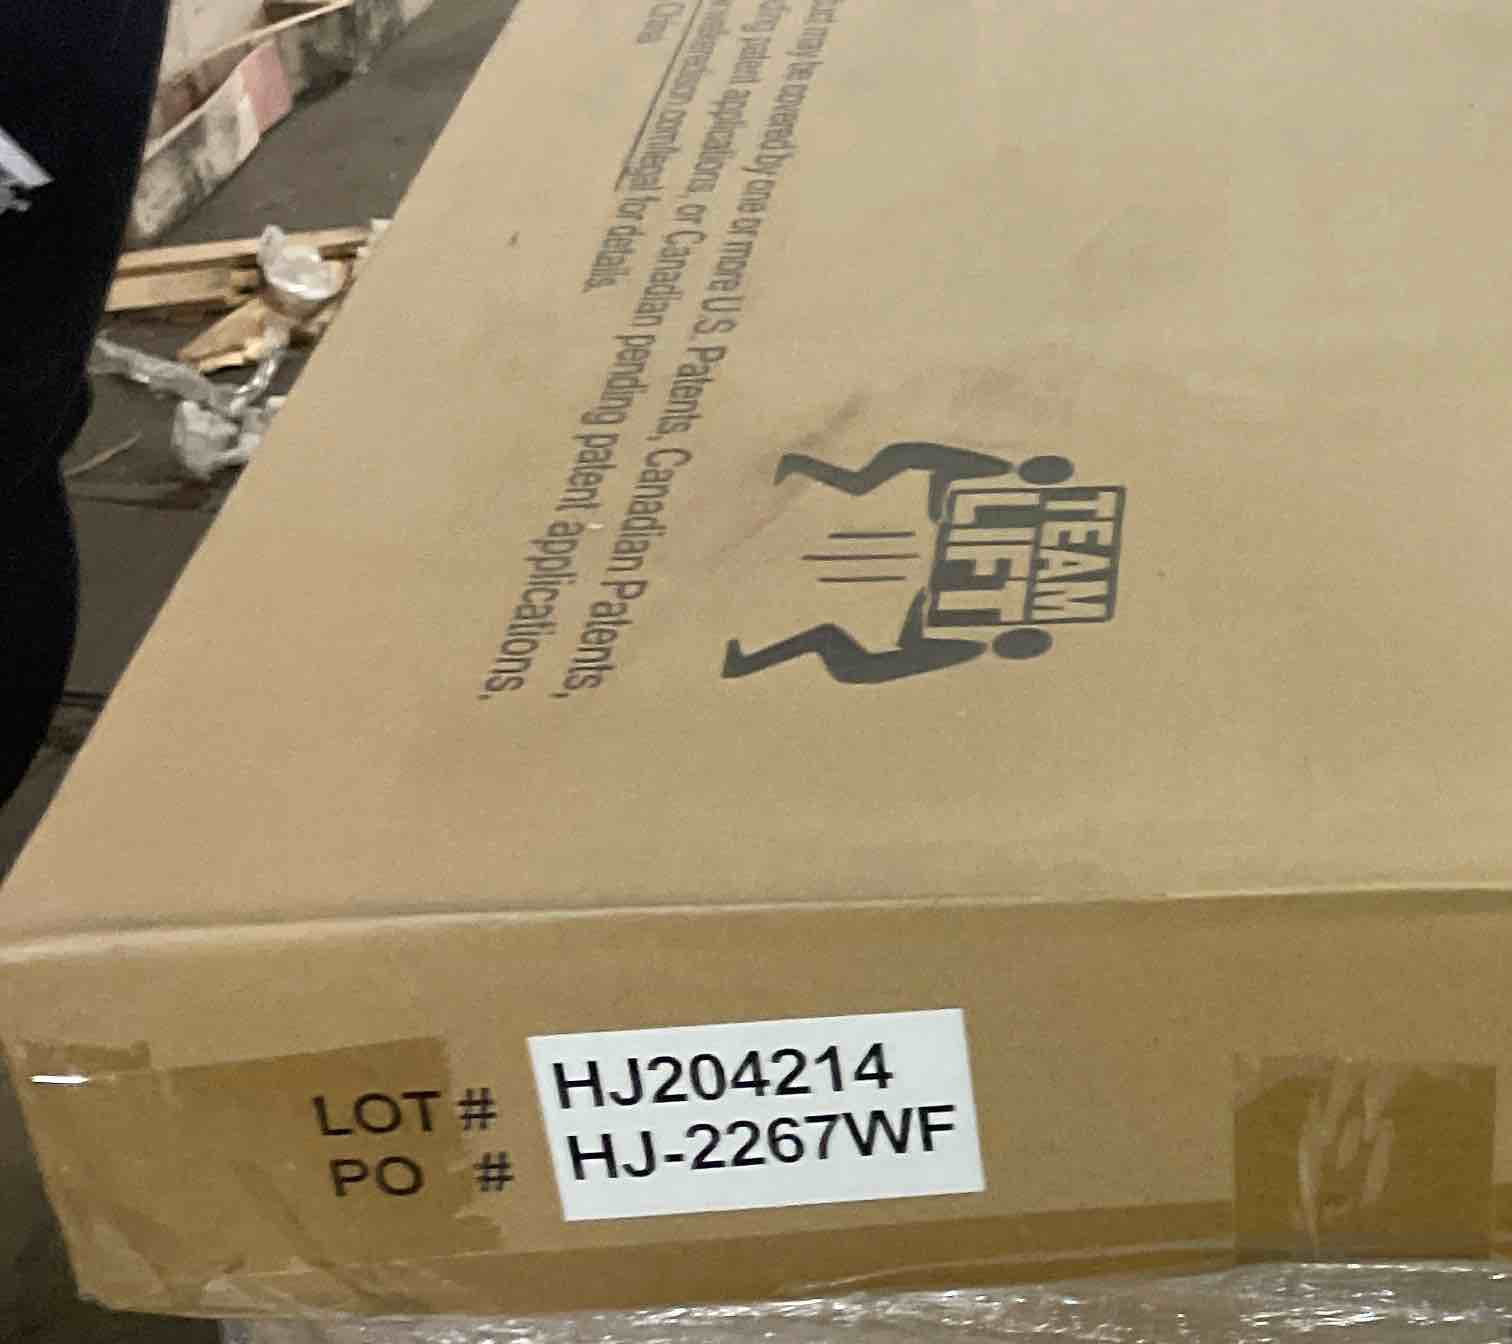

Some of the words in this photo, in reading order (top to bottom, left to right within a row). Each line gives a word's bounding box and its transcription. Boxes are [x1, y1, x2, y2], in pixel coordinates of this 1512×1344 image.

[758, 84, 808, 150] covered
[735, 179, 777, 213] one
[741, 146, 797, 176] by
[615, 196, 662, 220] for
[671, 204, 707, 225] or
[727, 217, 762, 236] or
[579, 224, 646, 294] details.
[628, 229, 708, 328] Canadian
[706, 240, 754, 291] more
[579, 334, 657, 425] pending
[645, 345, 728, 441] Patents,
[553, 433, 621, 512] patent
[605, 447, 694, 572] Canadian
[936, 492, 1040, 626] LIFT
[1030, 487, 1118, 621] TEAM
[477, 520, 585, 701] applications.
[548, 579, 649, 699] Patents,
[552, 1042, 894, 1110] HJ204214
[312, 1090, 441, 1137] LOT
[457, 1087, 498, 1131] #
[566, 1103, 958, 1181] HJ-2267WF
[331, 1156, 424, 1197] PO
[474, 1151, 515, 1194] #
